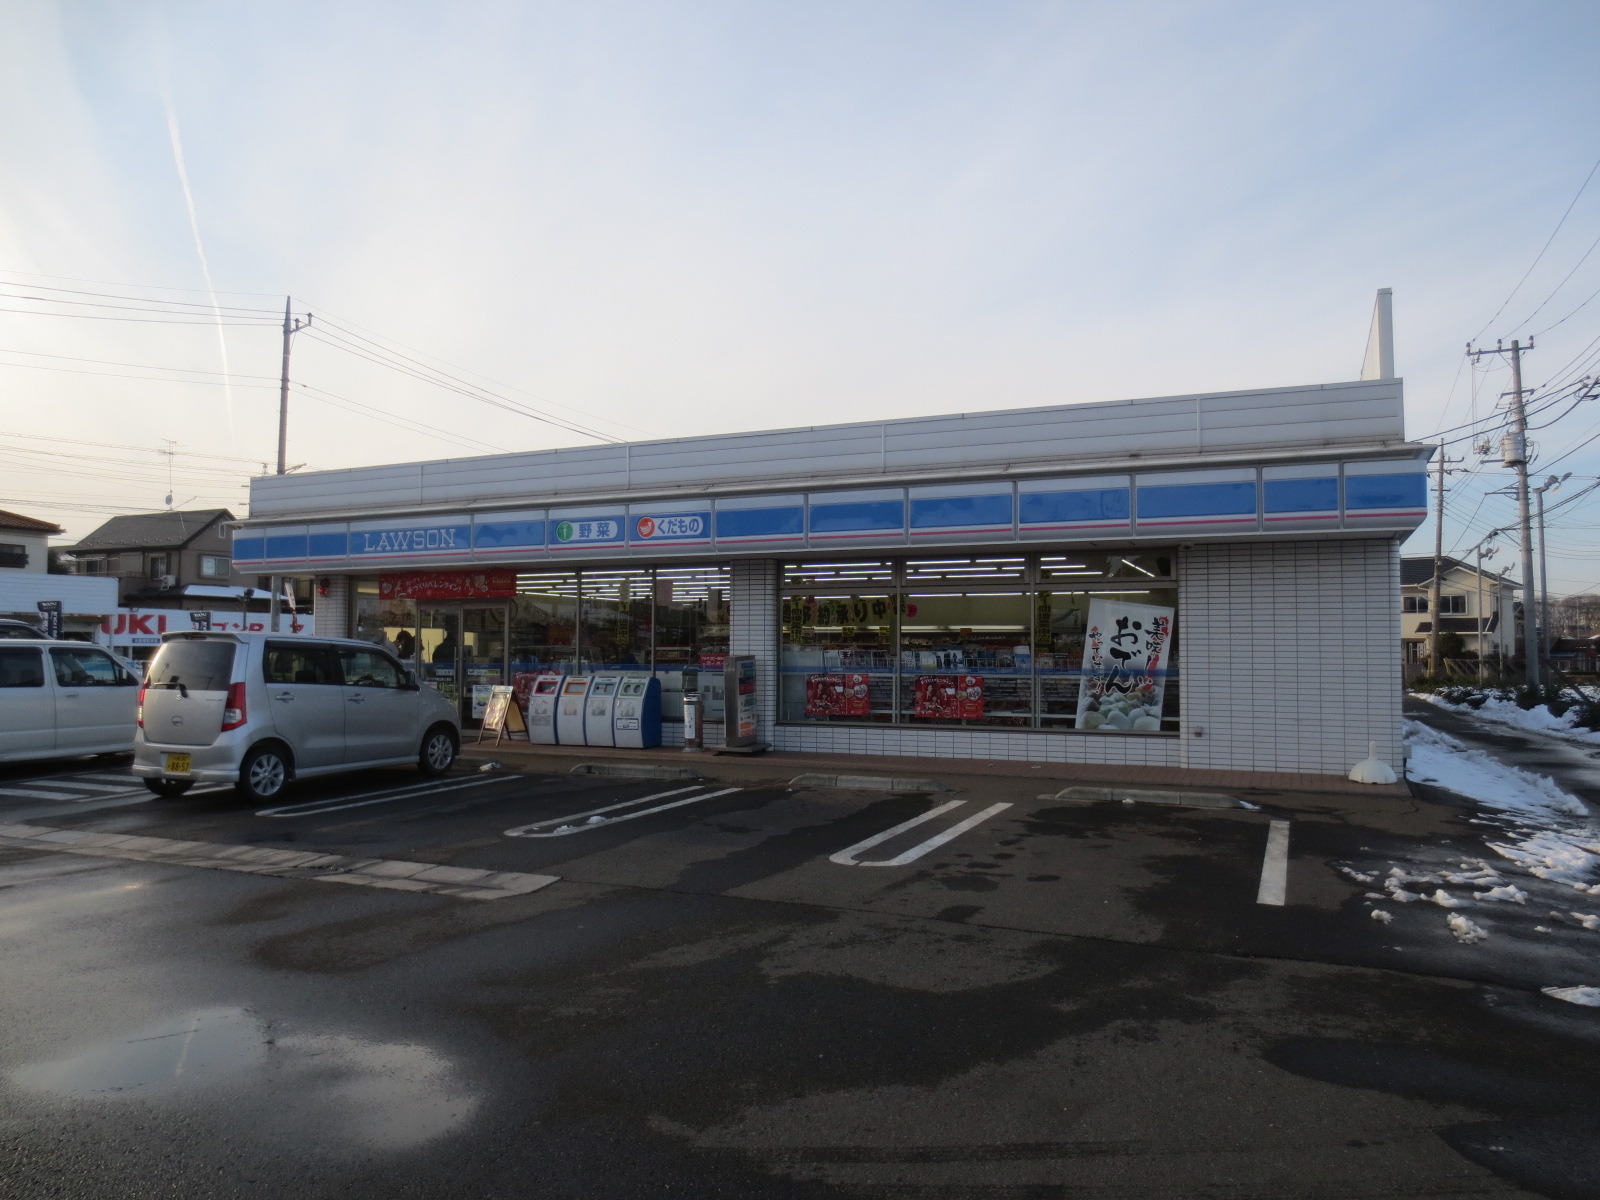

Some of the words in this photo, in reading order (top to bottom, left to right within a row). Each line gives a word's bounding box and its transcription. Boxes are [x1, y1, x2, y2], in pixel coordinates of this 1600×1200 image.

[578, 521, 611, 539] 野菜
[657, 518, 700, 535] くだもの
[363, 528, 456, 552] LAWSON
[1105, 615, 1142, 695] おでん
[1137, 616, 1165, 684] 美味しい
